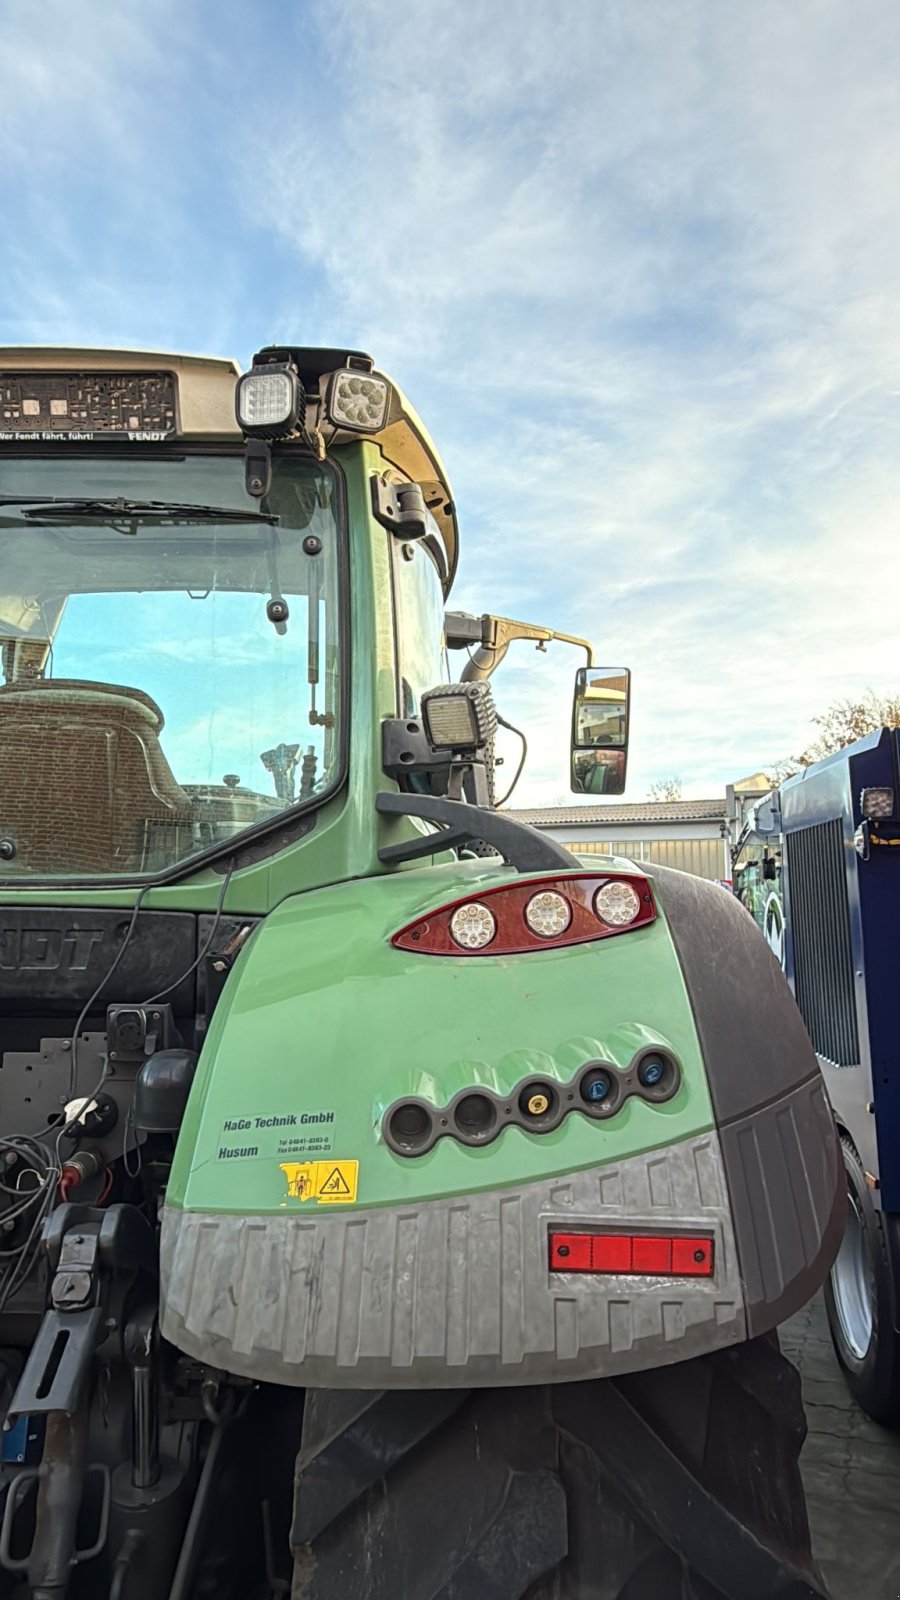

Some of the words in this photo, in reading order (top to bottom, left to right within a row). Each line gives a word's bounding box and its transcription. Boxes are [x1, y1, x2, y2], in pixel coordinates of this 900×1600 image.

[15, 432, 40, 440] Fendt
[68, 432, 94, 440] führt!
[128, 432, 167, 441] FENDT
[223, 1119, 252, 1132] HaGe
[254, 1115, 297, 1129] Technik
[300, 1112, 335, 1125] GmbH
[217, 1146, 259, 1159] Husum
